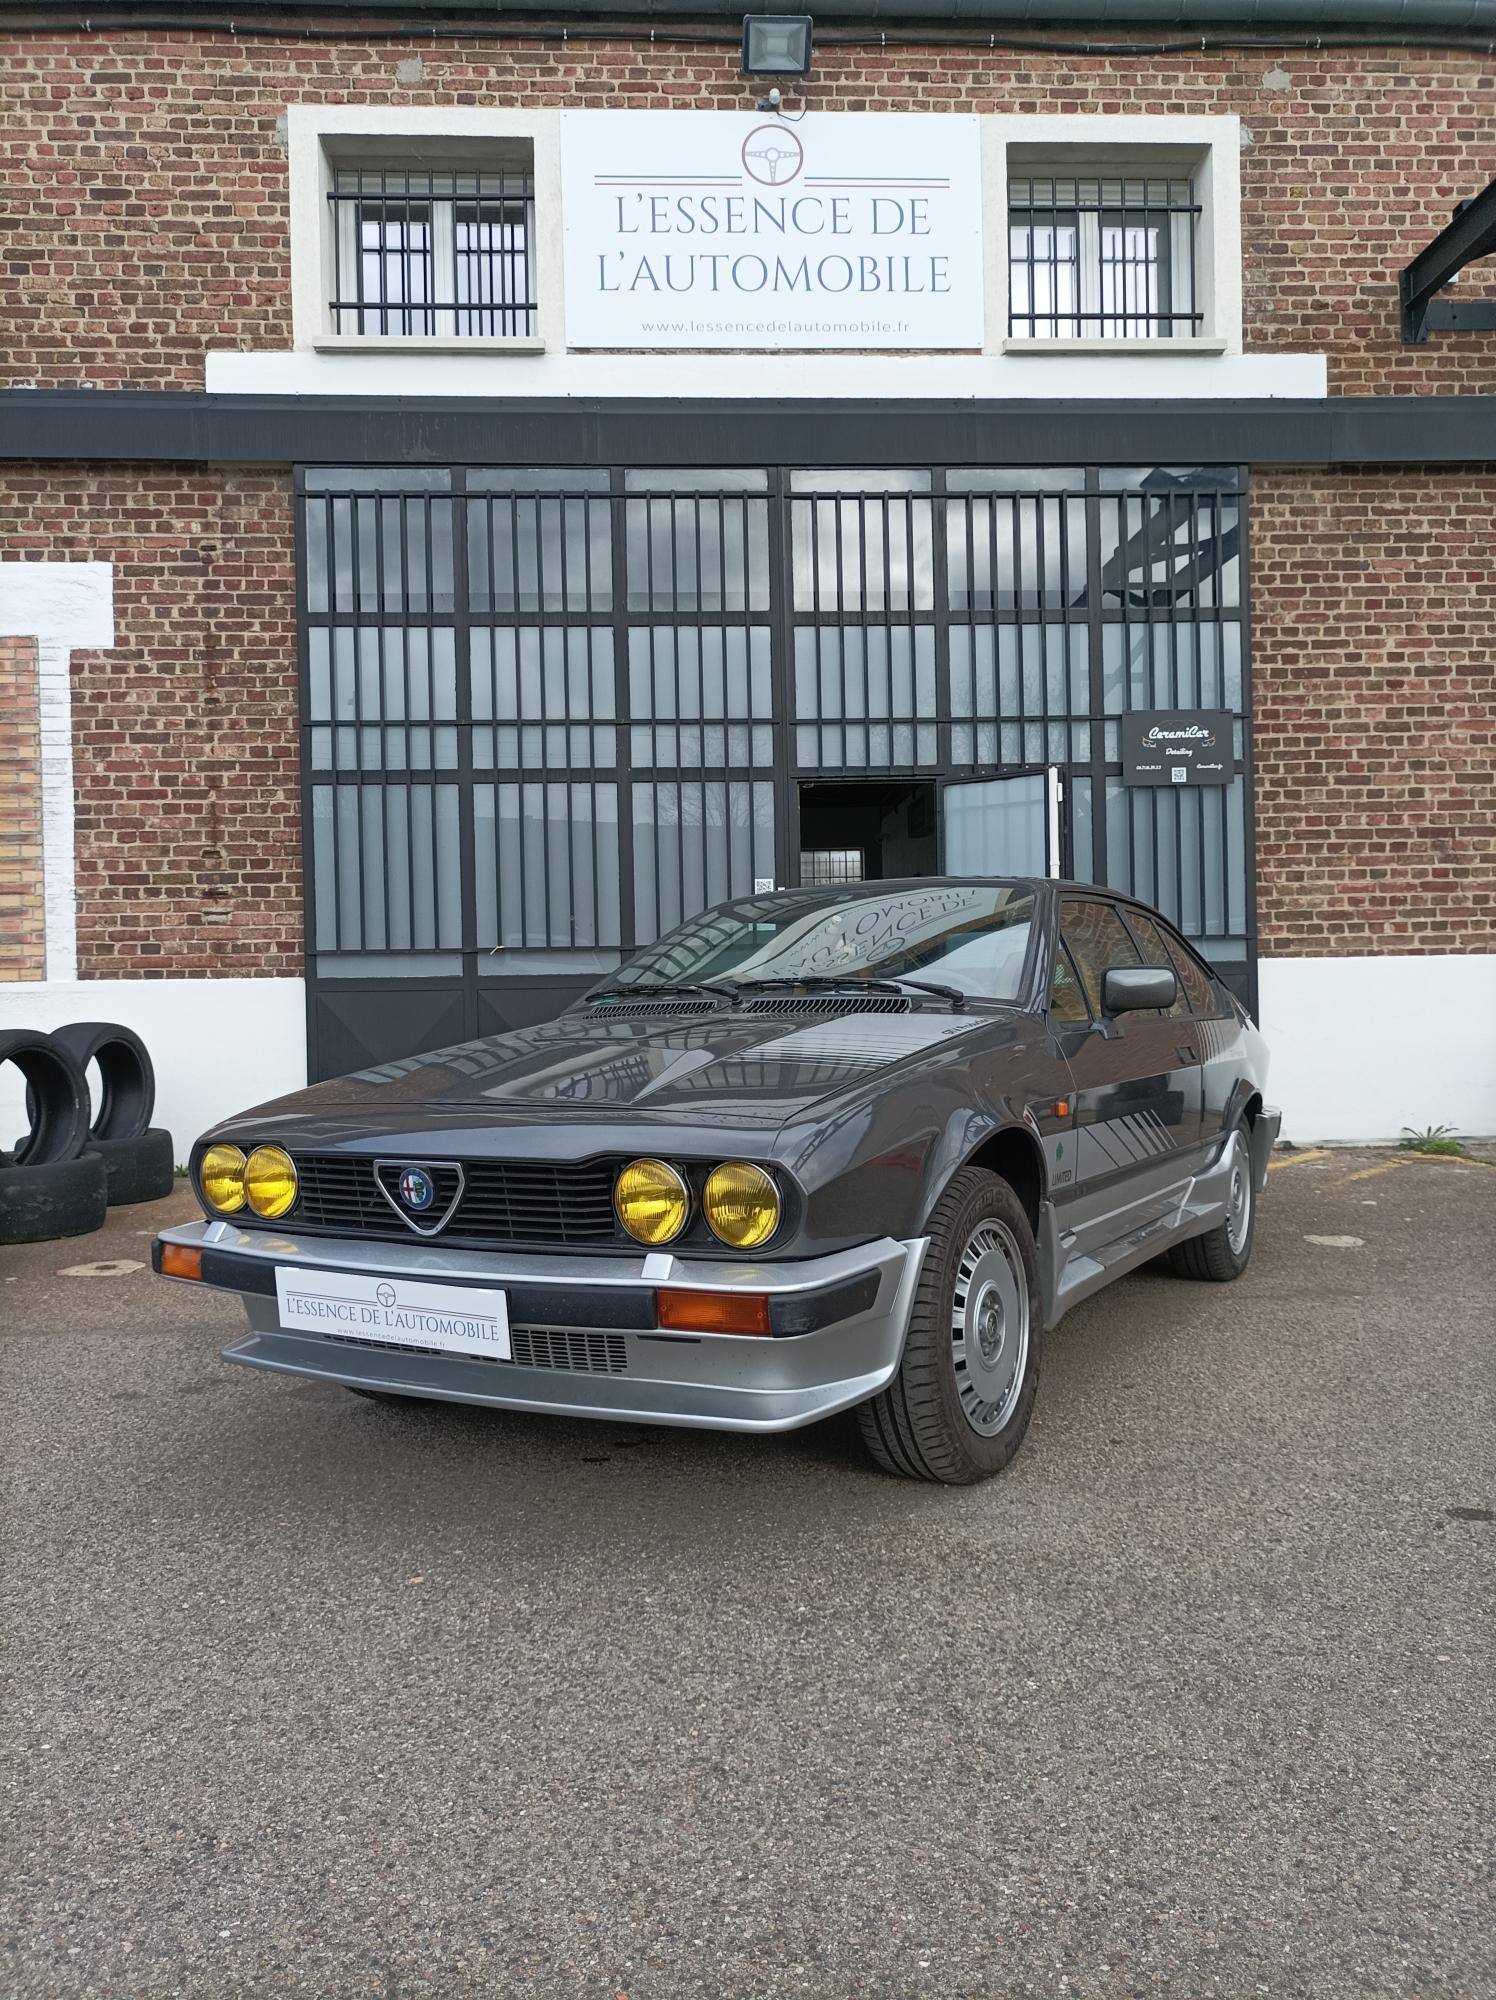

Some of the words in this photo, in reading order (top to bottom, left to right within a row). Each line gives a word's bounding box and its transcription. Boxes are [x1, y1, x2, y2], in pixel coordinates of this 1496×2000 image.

[615, 192, 854, 235] L'ESSENCE
[870, 197, 933, 236] DE
[596, 250, 953, 293] L'AUTOMOBILE
[641, 319, 910, 334] www.lessencedelautomobile.fr
[1148, 725, 1210, 740] CeramiCar
[286, 1297, 357, 1322] L'ESSENCE
[360, 1307, 381, 1325] DE
[384, 1310, 500, 1342] L'AUTOMOBILE
